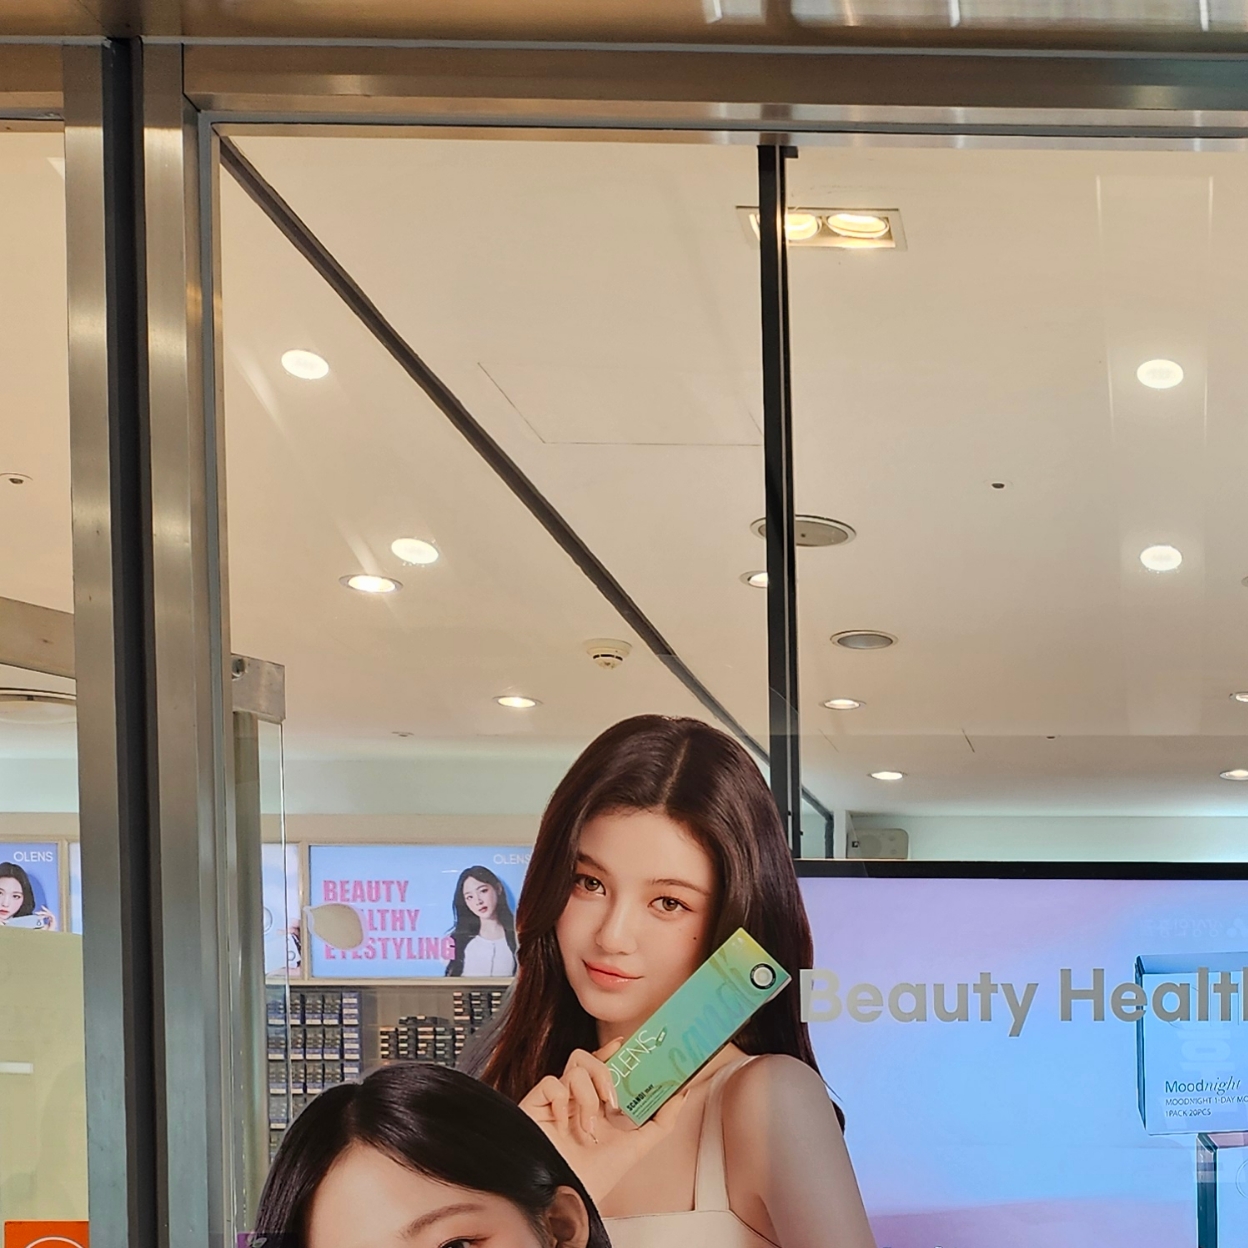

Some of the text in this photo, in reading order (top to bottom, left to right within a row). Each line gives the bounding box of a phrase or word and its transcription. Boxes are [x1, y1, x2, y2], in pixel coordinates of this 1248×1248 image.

[13, 851, 53, 862] OLENS
[493, 853, 531, 865] OLENS
[323, 880, 409, 903] BEAUTY
[367, 909, 420, 932] LTHY
[800, 968, 1039, 1037] Beauty
[1165, 1076, 1241, 1095] Moodnight
[1165, 1096, 1212, 1106] MOODNIGHT
[1214, 1095, 1235, 1104] 1-DAY
